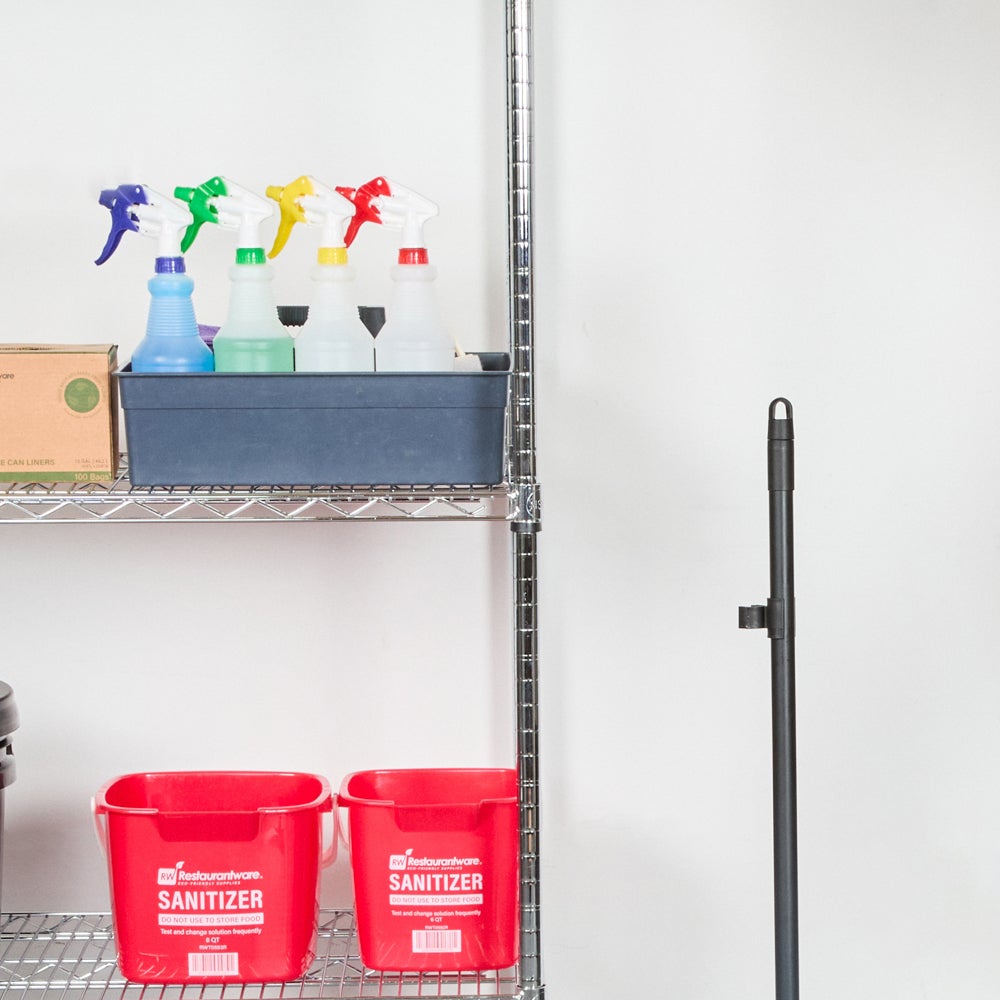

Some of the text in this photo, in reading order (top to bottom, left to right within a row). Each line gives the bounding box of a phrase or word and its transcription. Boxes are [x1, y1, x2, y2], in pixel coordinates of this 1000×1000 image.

[74, 473, 88, 481] 100
[389, 873, 483, 891] SANITIZER
[158, 890, 263, 910] SANITIZER
[413, 910, 433, 918] change
[455, 909, 481, 917] frequently
[161, 915, 261, 924] DO NOT USE TO STORE FOOD
[232, 927, 262, 935] frequently
